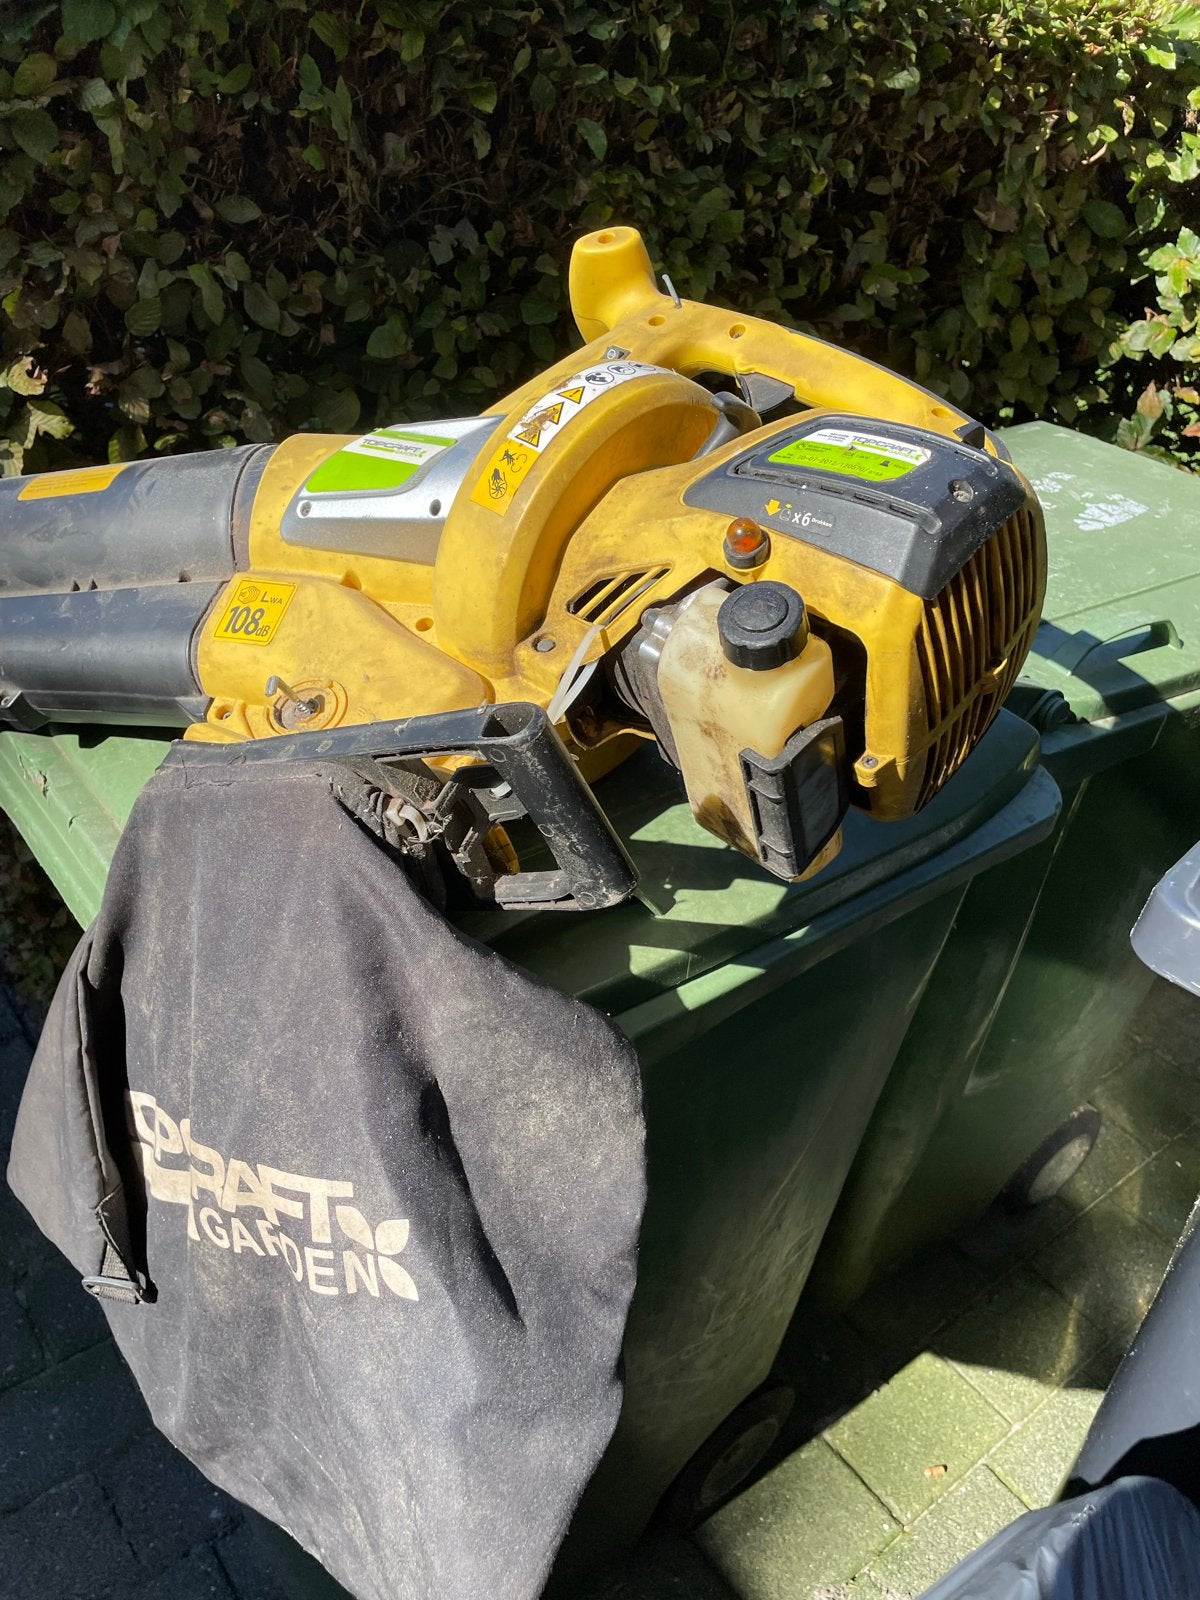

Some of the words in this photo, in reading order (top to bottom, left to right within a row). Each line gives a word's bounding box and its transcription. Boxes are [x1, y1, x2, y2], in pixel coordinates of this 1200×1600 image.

[362, 438, 421, 452] TOPCRAFT
[853, 436, 916, 454] TOPCRAFT
[199, 1207, 380, 1297] GARDEN
